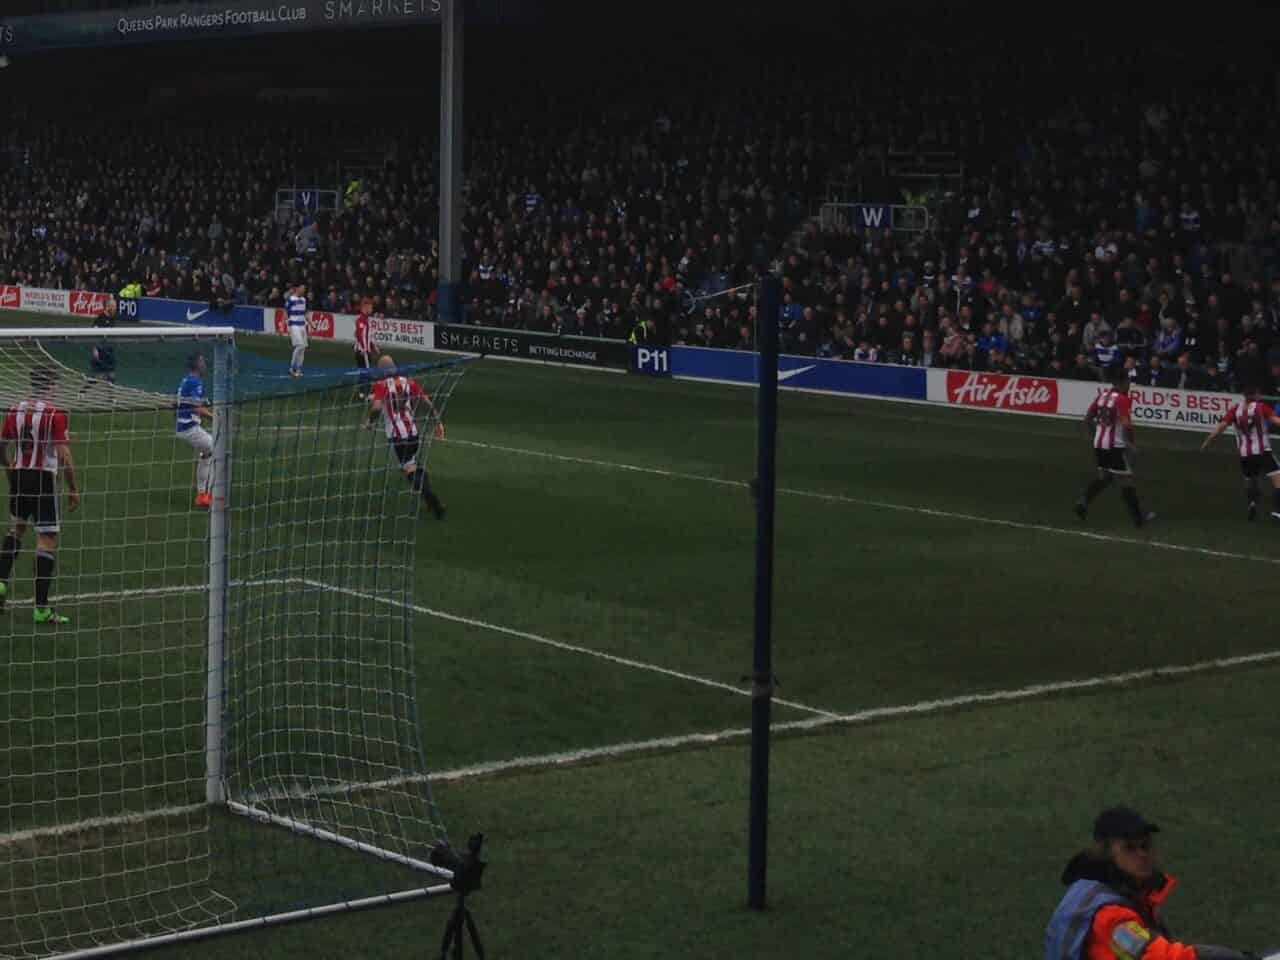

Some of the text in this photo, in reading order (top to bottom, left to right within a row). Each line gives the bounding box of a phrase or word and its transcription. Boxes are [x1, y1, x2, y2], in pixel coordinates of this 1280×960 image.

[154, 14, 179, 30] PARK
[180, 10, 224, 28] RANGERS
[224, 6, 277, 25] FOOTBALL
[277, 4, 307, 22] CLUB
[861, 206, 884, 229] W
[119, 301, 137, 316] P10
[370, 321, 425, 336] RLD'S BEST
[637, 348, 669, 373] P11
[1130, 390, 1232, 414] RLD'S BEST
[1175, 411, 1223, 426] AIRLIN
